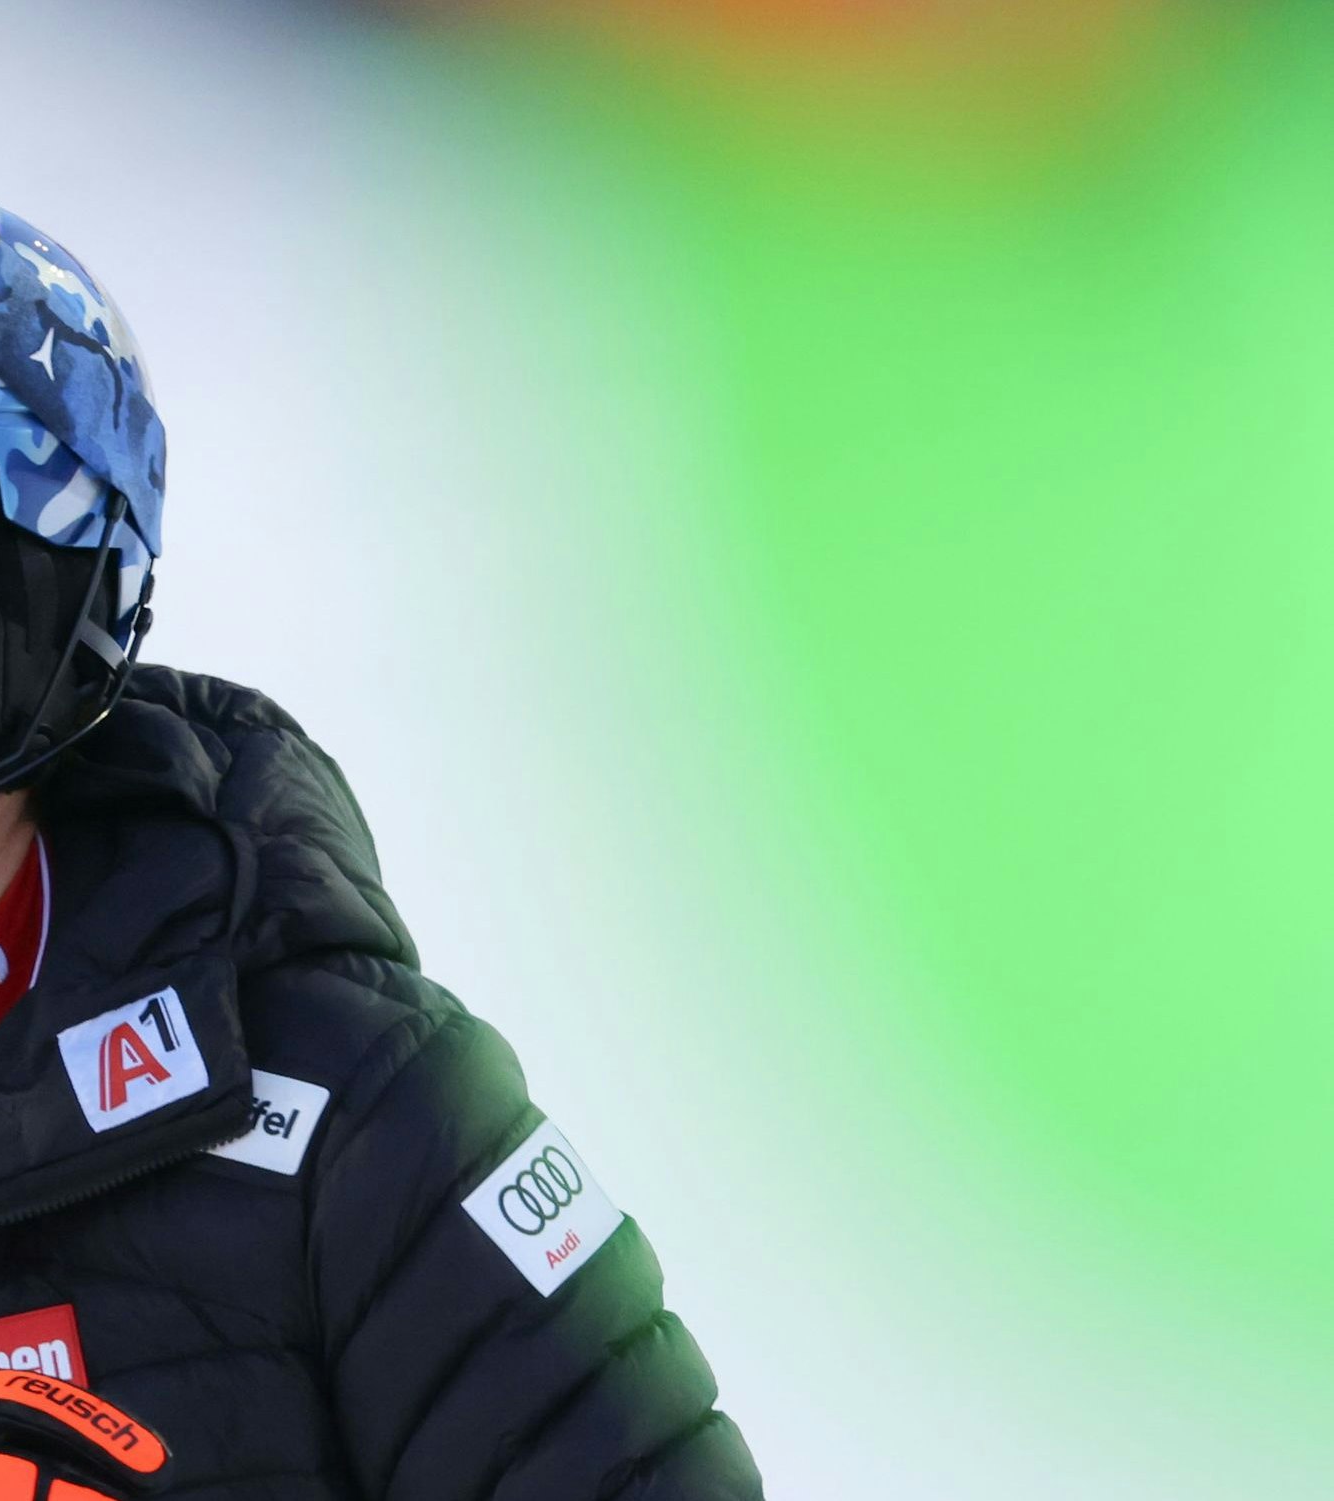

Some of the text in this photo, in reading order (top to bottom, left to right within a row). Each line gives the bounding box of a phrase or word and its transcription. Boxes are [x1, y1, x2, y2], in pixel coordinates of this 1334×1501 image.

[98, 996, 181, 1113] A1
[252, 1097, 300, 1140] fel
[545, 1228, 581, 1270] Audi
[4, 1374, 140, 1451] reusch
